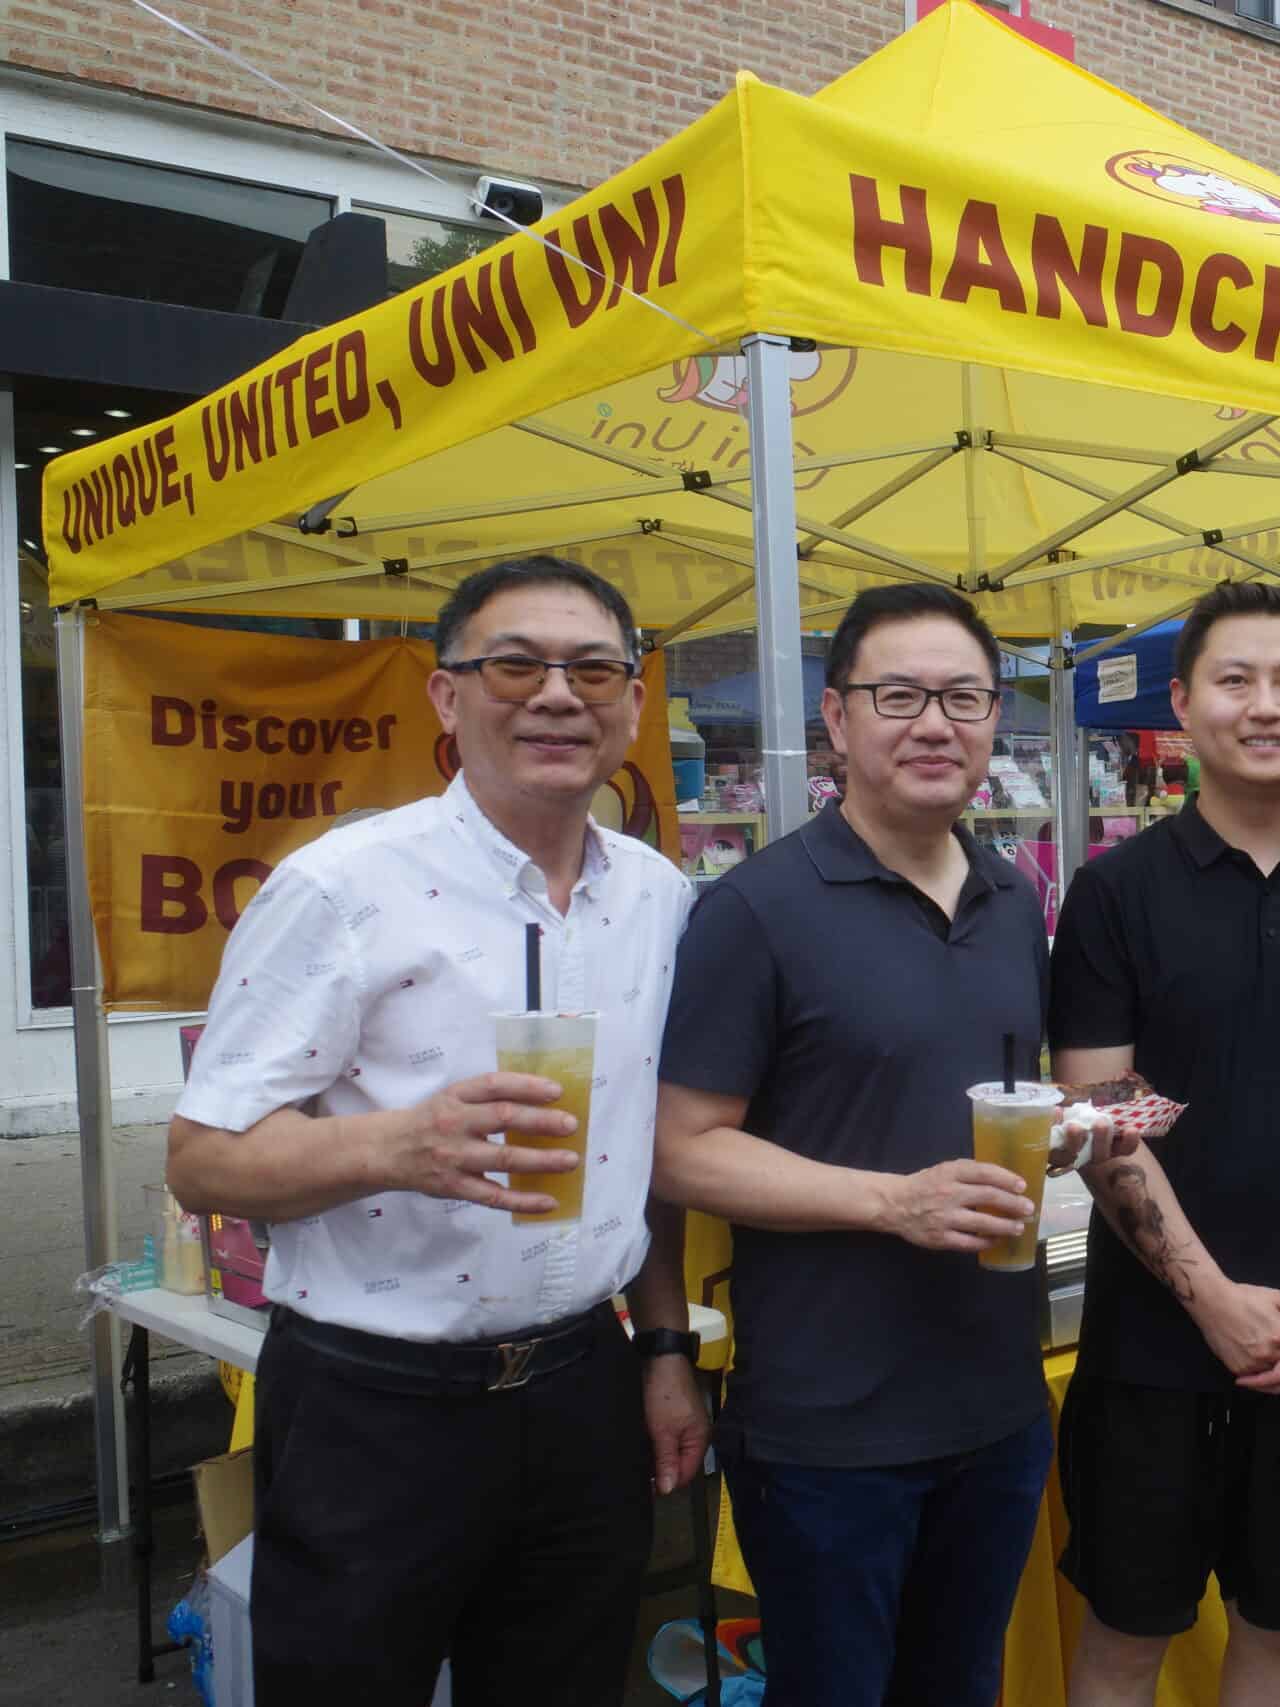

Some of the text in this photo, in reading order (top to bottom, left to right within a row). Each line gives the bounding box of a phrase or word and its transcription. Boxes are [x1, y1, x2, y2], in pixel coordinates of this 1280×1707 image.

[62, 174, 686, 555] UNIQUE, UNITED, UNI UNI
[151, 695, 397, 755] Discover
[220, 780, 342, 834] your
